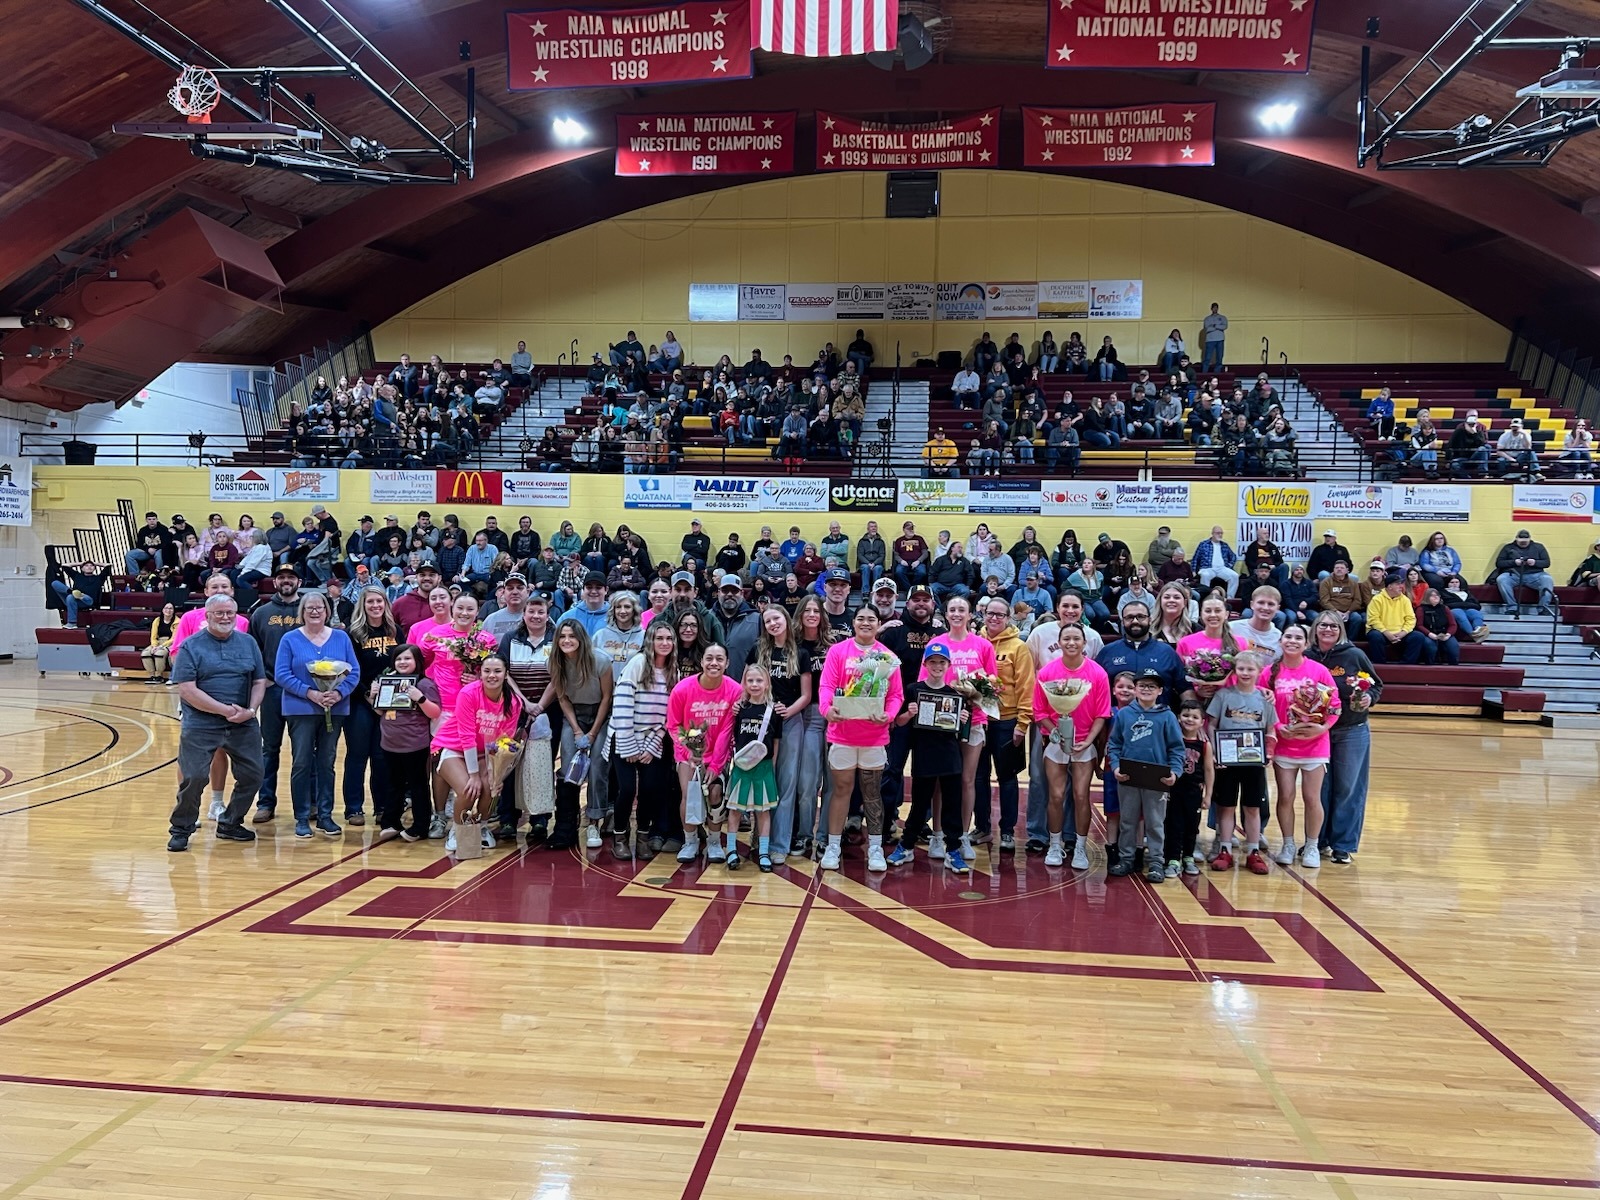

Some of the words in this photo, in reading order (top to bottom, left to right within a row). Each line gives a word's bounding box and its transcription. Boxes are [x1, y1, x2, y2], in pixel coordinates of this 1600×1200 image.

[1104, 0, 1150, 14] NAIA
[1159, 0, 1266, 15] WRESTLING
[568, 15, 605, 35] NAIA
[612, 10, 690, 34] NATIONAL
[1076, 16, 1166, 37] NATIONAL
[1173, 18, 1282, 40] CHAMPIONS
[536, 39, 624, 60] WRESTLING
[630, 30, 724, 56] CHAMPIONS
[1158, 41, 1198, 62] 1999
[610, 60, 648, 80] 1998
[656, 117, 686, 132] NAIA
[694, 116, 756, 132] NATIONAL
[1070, 113, 1099, 127] NAIA
[1105, 109, 1166, 127] NATIONAL
[860, 120, 888, 132] NAIA
[895, 119, 954, 132] NATIONAL
[832, 133, 907, 150] BASKETBALL
[912, 130, 982, 150] CHAMPIONS
[1044, 128, 1114, 144] WRESTLING
[1120, 126, 1192, 144] CHAMPIONS
[630, 136, 700, 152] WRESTLING
[708, 134, 782, 152] CHAMPIONS
[840, 150, 868, 166] 1993
[872, 152, 917, 164] WOMEN'S
[921, 150, 964, 164] DIVISION
[966, 150, 974, 162] II
[1103, 146, 1132, 162] 1992
[692, 155, 718, 170] 1991
[742, 286, 776, 300] Havre
[887, 286, 902, 295] ACE
[904, 283, 934, 294] TOWING
[936, 284, 958, 292] QUIT
[936, 292, 960, 302] NOW
[1090, 288, 1122, 310] Lewis
[215, 474, 235, 482] KORB
[374, 471, 434, 481] NorthWestern
[215, 482, 270, 491] CONSTRUCTION
[694, 480, 759, 492] NAULT
[832, 485, 890, 498] altana
[904, 481, 945, 492] PRAIRIE
[1116, 484, 1152, 494] Master
[1155, 485, 1188, 496] Sports
[775, 486, 827, 503] printing
[1042, 490, 1088, 503] Stokes
[1116, 494, 1148, 504] Custom
[1151, 494, 1188, 504] Apparel
[1242, 485, 1309, 515] Northern
[1327, 489, 1362, 498] Everyone
[1322, 500, 1382, 509] BULLHOOK
[1429, 498, 1460, 506] Financial
[1291, 522, 1311, 542] ZOO
[544, 648, 550, 656] N
